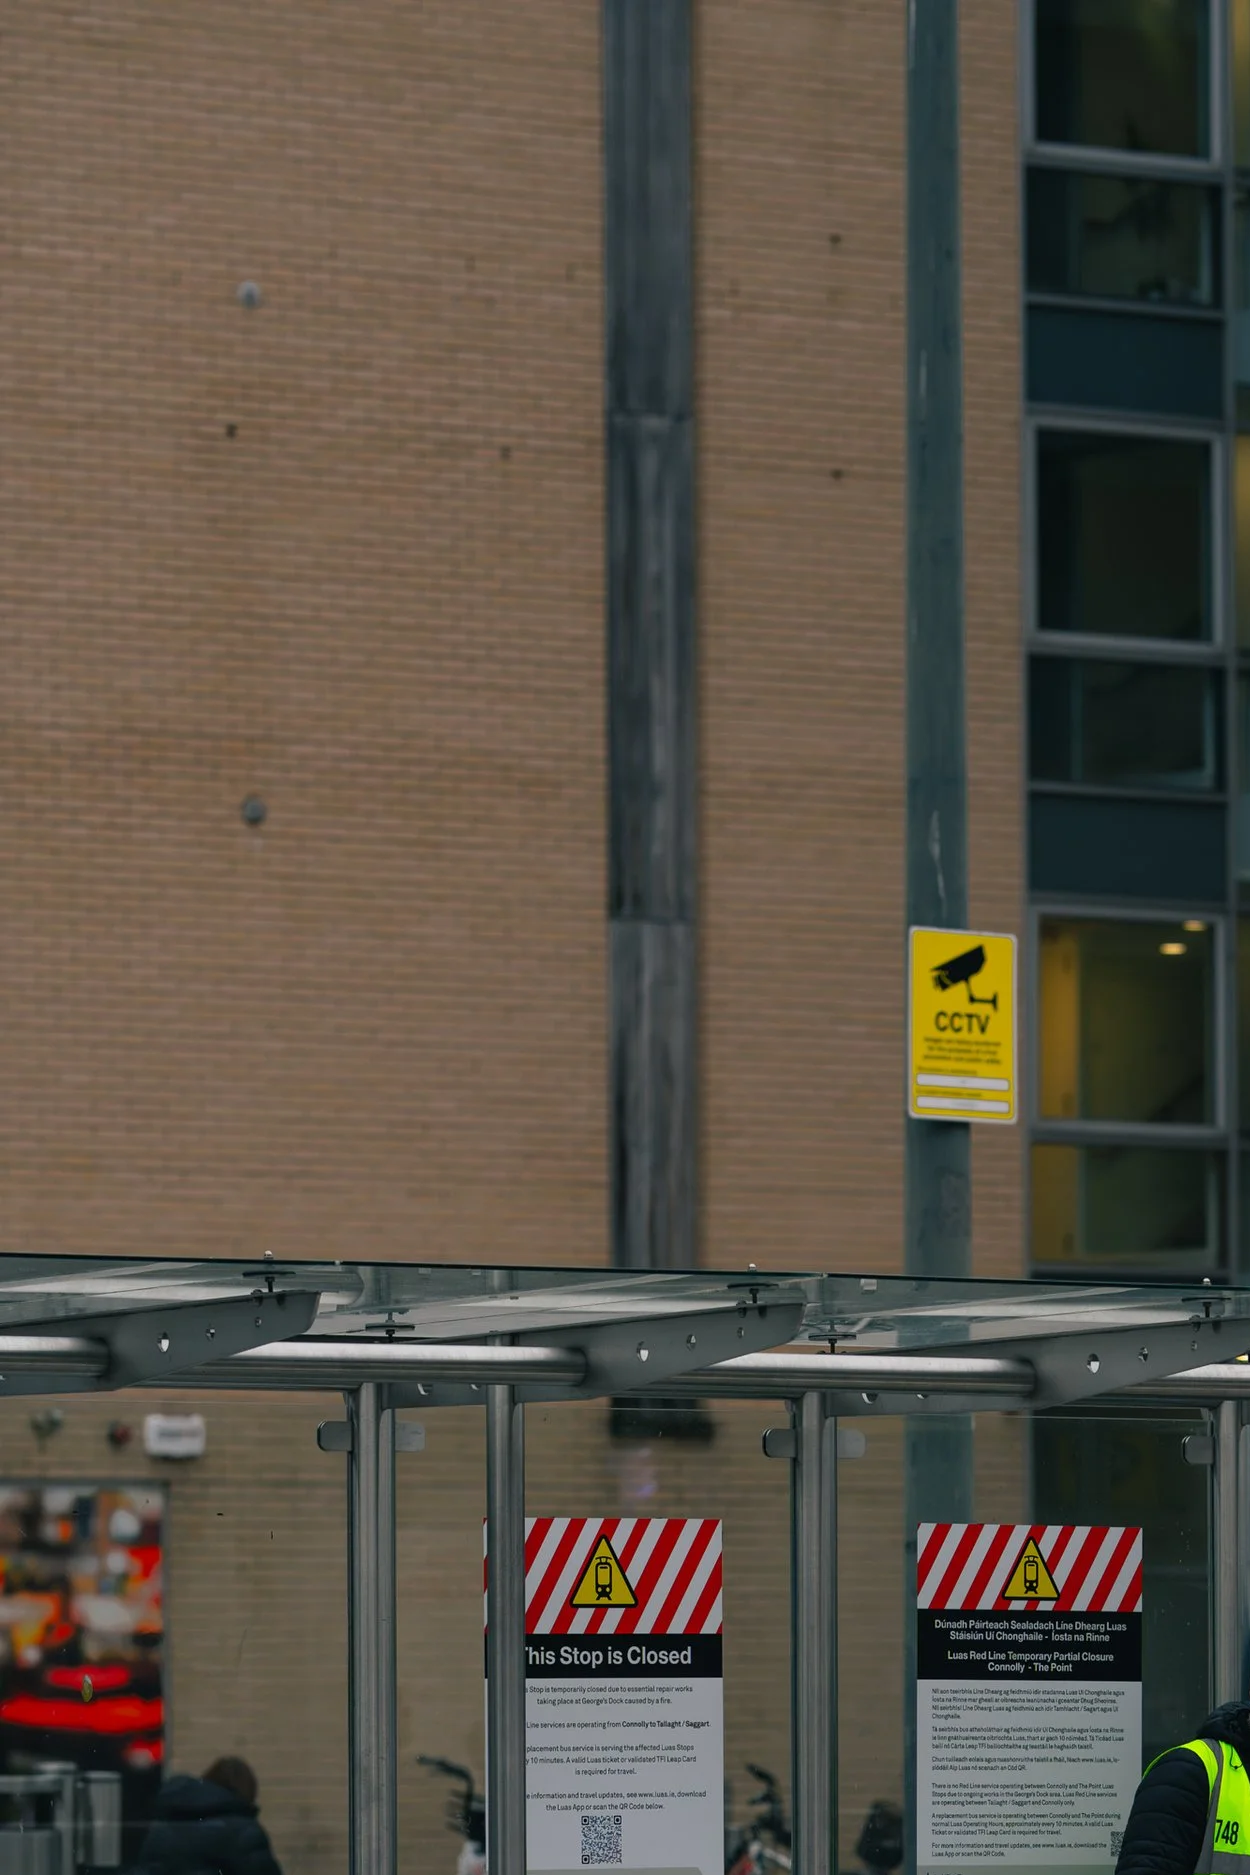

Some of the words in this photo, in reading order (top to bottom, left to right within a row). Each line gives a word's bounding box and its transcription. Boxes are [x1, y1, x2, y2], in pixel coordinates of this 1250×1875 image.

[935, 1011, 990, 1034] CCTV
[934, 1620, 968, 1629] Dúnadh
[969, 1620, 1009, 1629] Páirteach
[1010, 1621, 1054, 1630] Sealadach
[1055, 1621, 1073, 1630] Líne
[1074, 1621, 1105, 1632] Dhearg
[1106, 1622, 1127, 1630] Luas
[949, 1632, 984, 1640] Stáisiún
[985, 1632, 995, 1641] Uí
[996, 1632, 1043, 1642] Chonghaile
[1051, 1630, 1072, 1641] Íosta
[1086, 1633, 1110, 1641] Rinne
[560, 1646, 603, 1669] Stop
[607, 1646, 623, 1665] is
[627, 1645, 692, 1665] Closed
[947, 1651, 968, 1660] Luas
[969, 1651, 987, 1660] Red
[988, 1651, 1006, 1660] Line
[1008, 1652, 1052, 1662] Temporary
[1053, 1652, 1081, 1661] Partial
[1081, 1652, 1114, 1661] Closure
[987, 1663, 1025, 1673] Connolly
[1034, 1663, 1049, 1672] The
[1050, 1663, 1072, 1672] Point
[529, 1686, 544, 1694] Stop
[551, 1686, 586, 1694] temporarily
[537, 1698, 556, 1706] taking
[557, 1698, 574, 1706] place
[581, 1698, 608, 1706] George's
[647, 1697, 655, 1705] by
[622, 1721, 649, 1729] Connolly
[657, 1721, 681, 1729] Tallaght
[685, 1721, 711, 1729] Saggart.
[526, 1745, 559, 1753] placement
[601, 1745, 623, 1753] serving
[666, 1756, 682, 1764] Leap
[581, 1769, 607, 1777] required
[598, 1792, 625, 1800] updates,
[572, 1804, 585, 1812] App
[1215, 1819, 1239, 1846] 748
